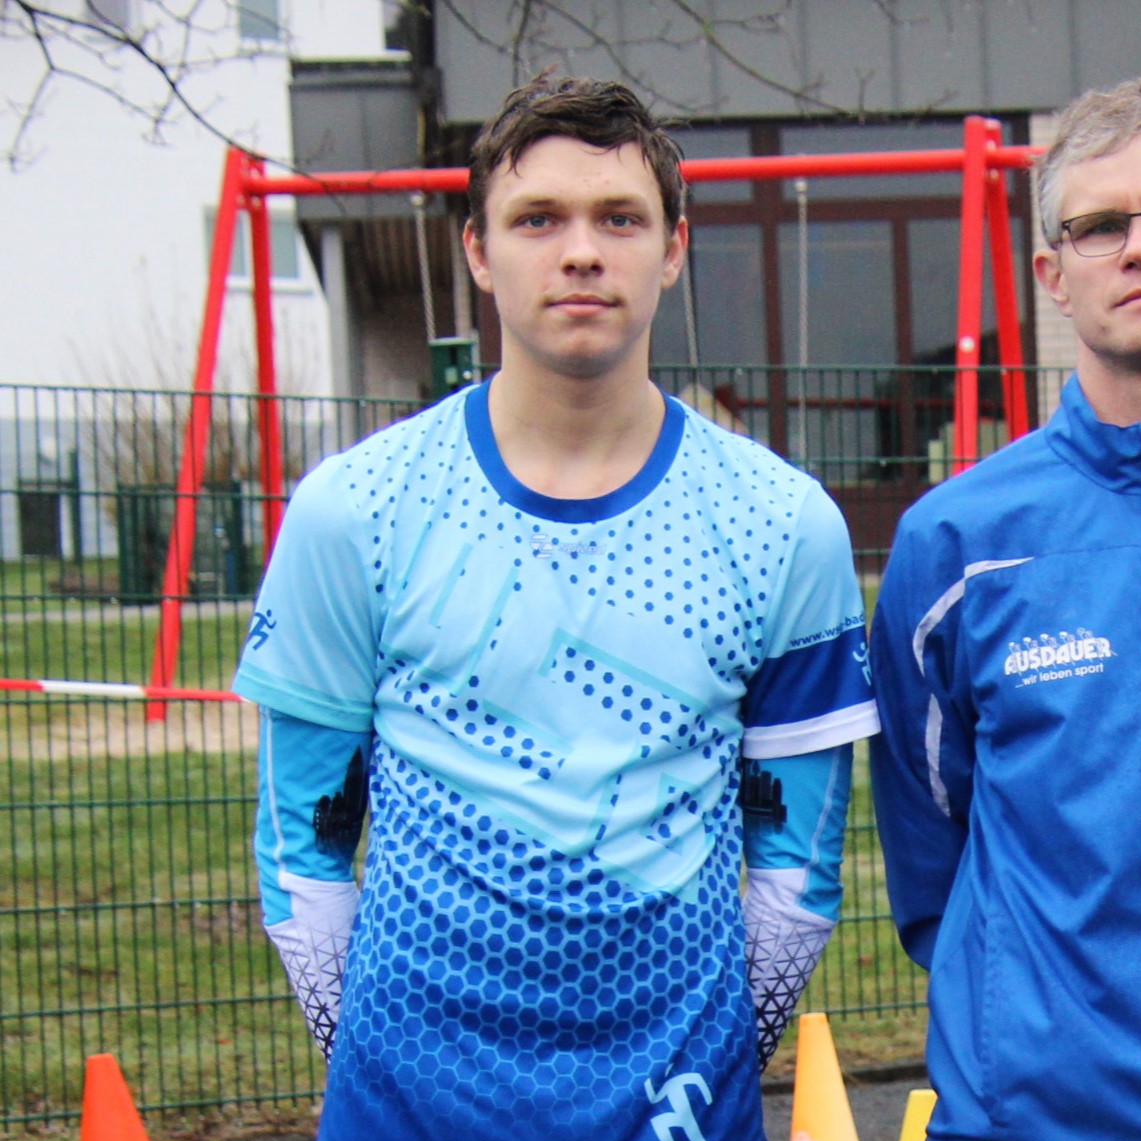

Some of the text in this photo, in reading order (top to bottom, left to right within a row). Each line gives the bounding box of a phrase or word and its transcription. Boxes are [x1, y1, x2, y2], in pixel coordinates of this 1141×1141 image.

[1005, 637, 1112, 675] AUSDAUER
[1040, 668, 1073, 682] leben
[1074, 663, 1104, 677] sport
